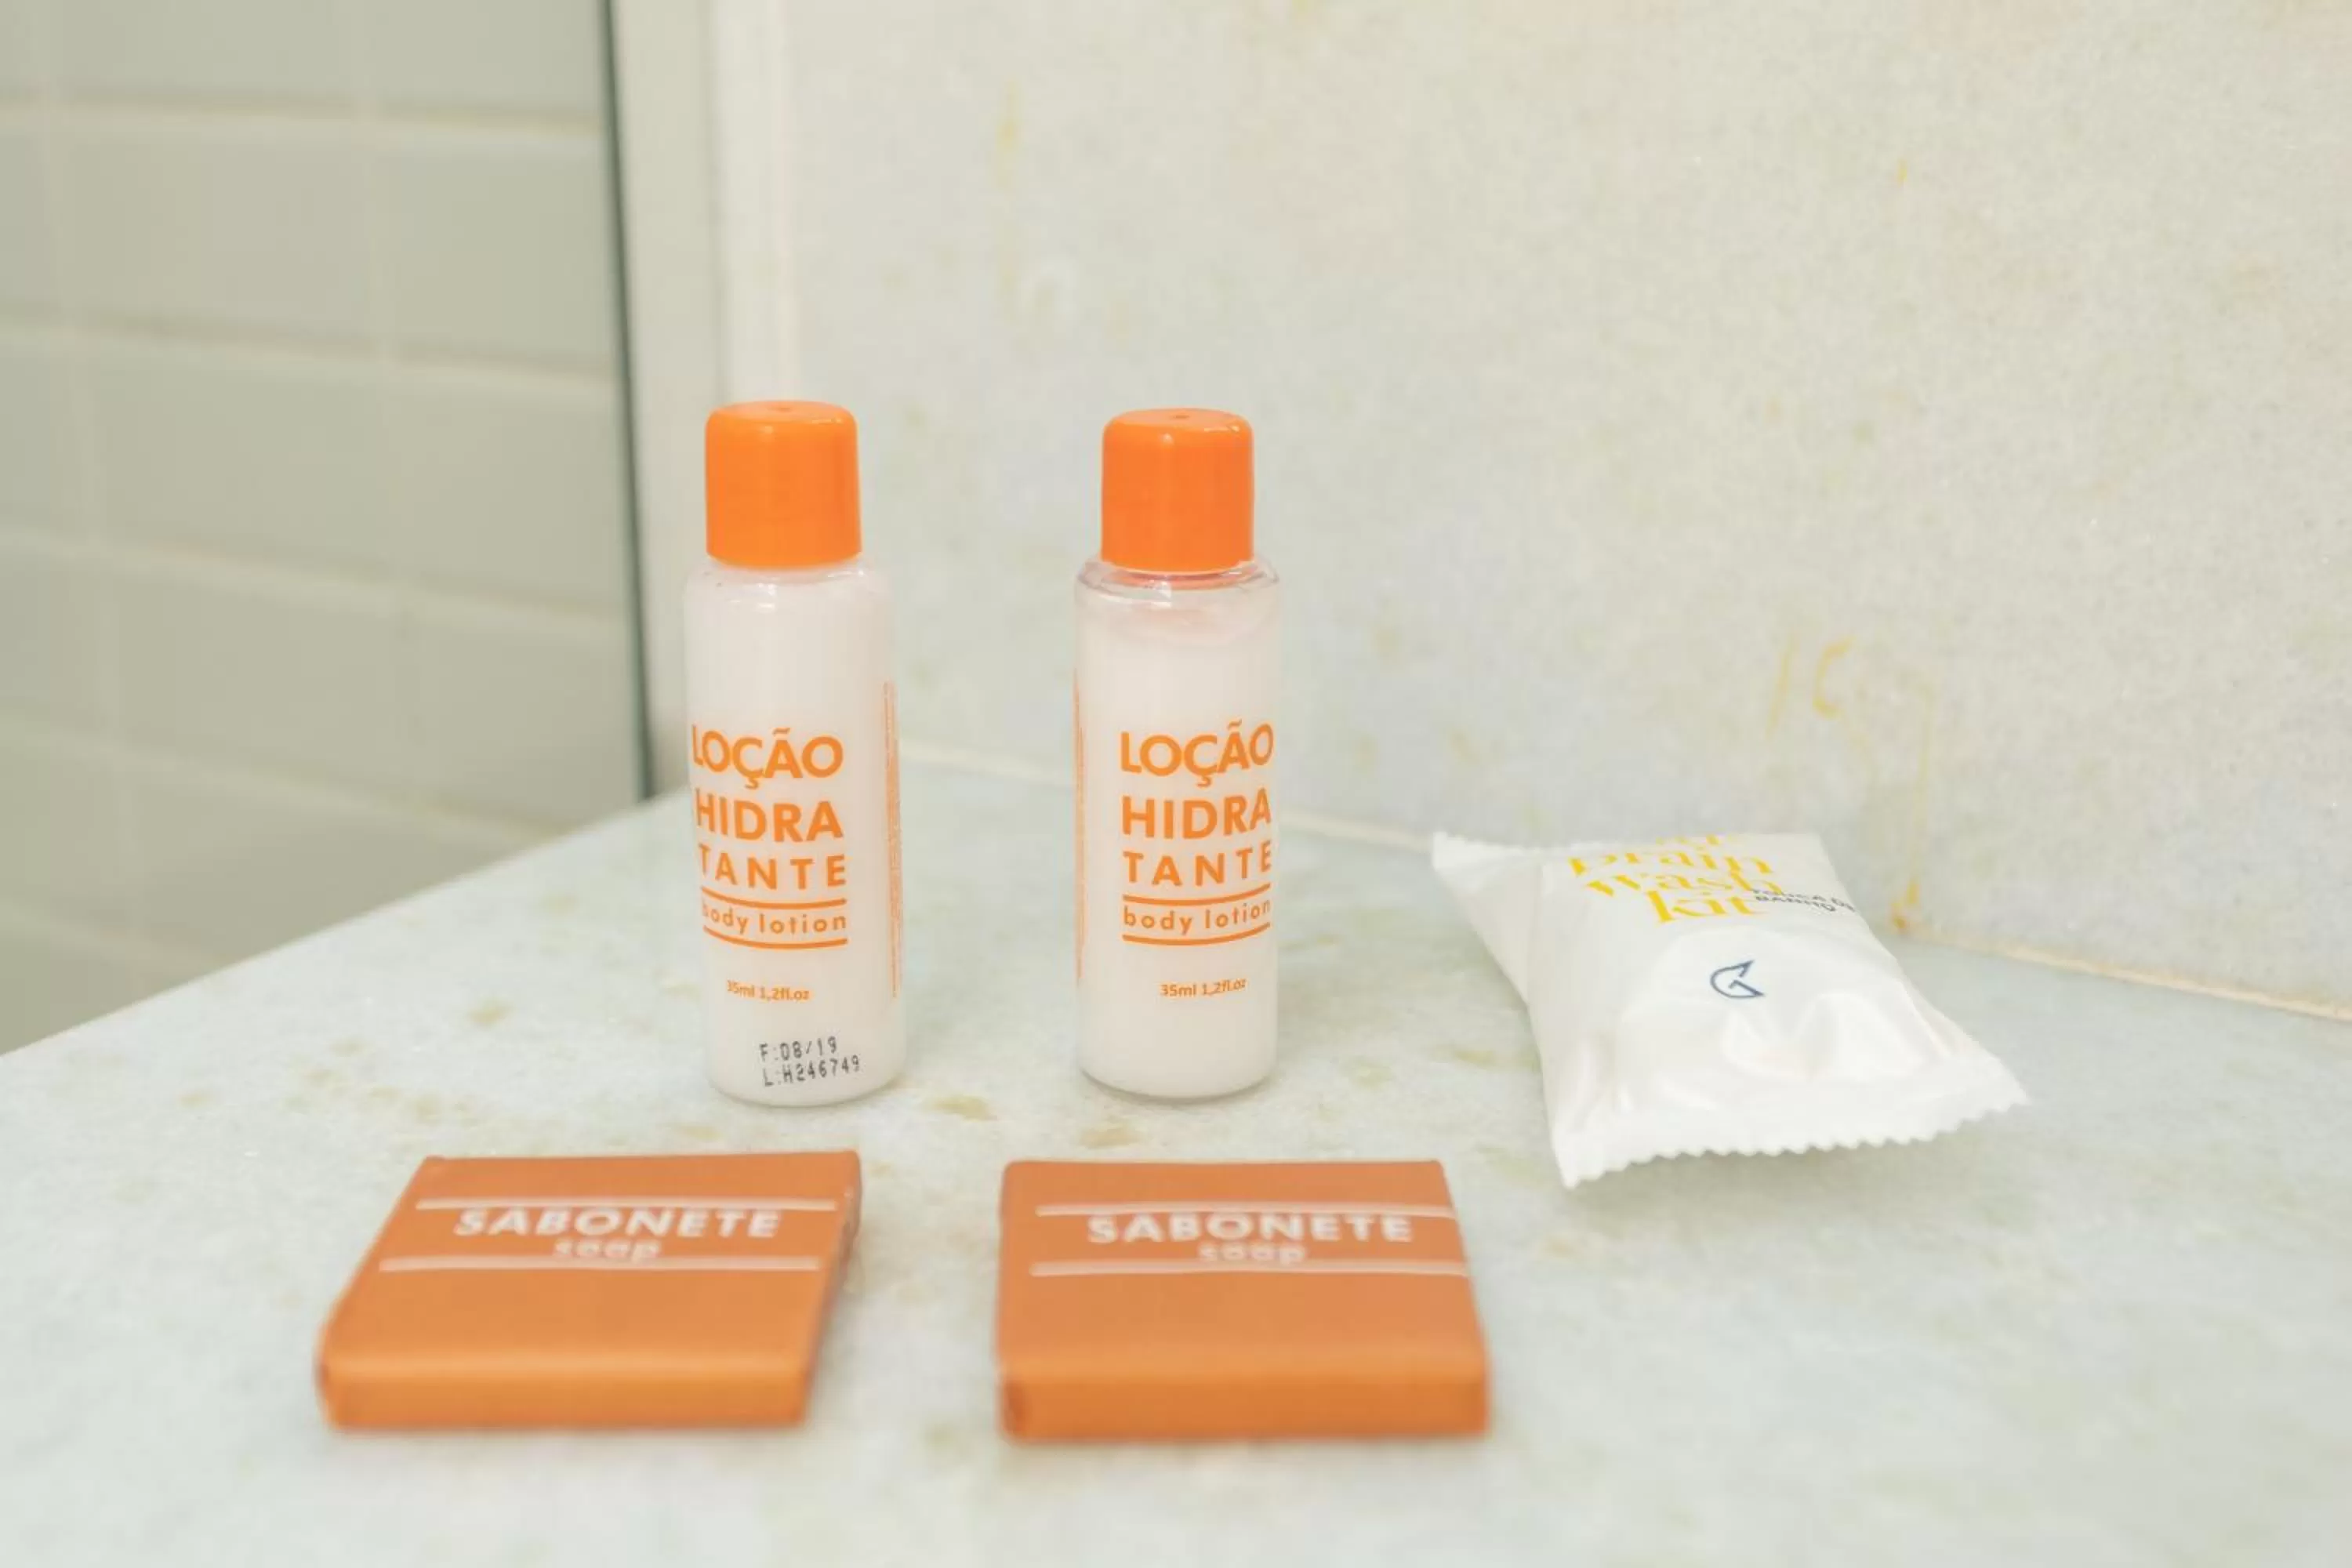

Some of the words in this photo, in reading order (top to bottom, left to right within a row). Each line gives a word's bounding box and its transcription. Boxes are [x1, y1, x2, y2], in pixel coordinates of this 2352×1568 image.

[691, 723, 844, 789] LOÇÃO
[1120, 720, 1274, 788] LOÇÃO
[695, 788, 844, 843] HIDRA
[1122, 787, 1272, 840] HIDRA
[699, 843, 846, 890] TANTE
[1122, 840, 1272, 887] TANTE
[1123, 906, 1192, 935] body
[1205, 899, 1272, 930] lotion
[1648, 890, 1769, 923] kit
[760, 913, 846, 935] lotion
[1160, 983, 1197, 998] 35ml
[452, 1206, 781, 1237] SABONETE
[1087, 1212, 1414, 1243] SABONETE
[552, 1238, 662, 1261] soap
[1197, 1240, 1308, 1265] soap
